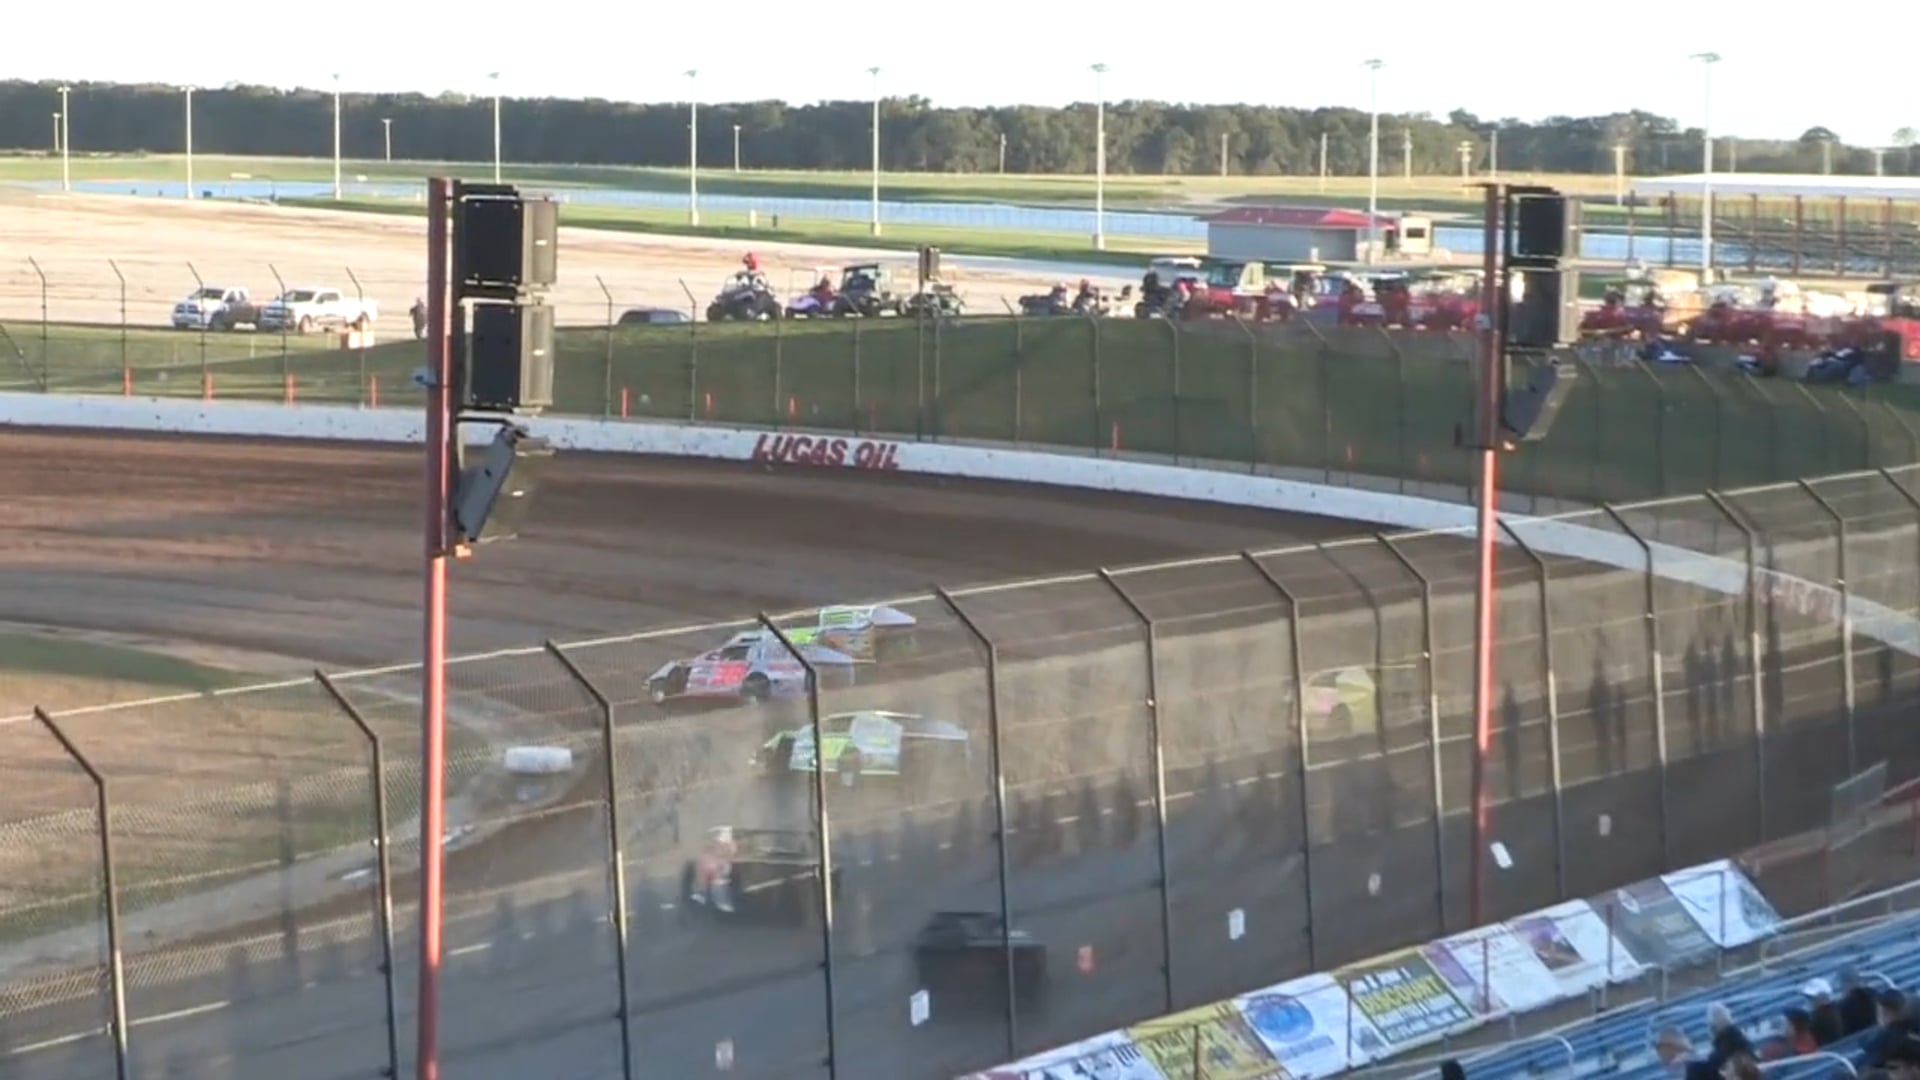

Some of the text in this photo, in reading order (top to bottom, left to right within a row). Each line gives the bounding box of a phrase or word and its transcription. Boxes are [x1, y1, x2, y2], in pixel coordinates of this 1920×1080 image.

[752, 433, 899, 471] LUCAS OIL
[1356, 976, 1442, 1014] DISCOUNT
